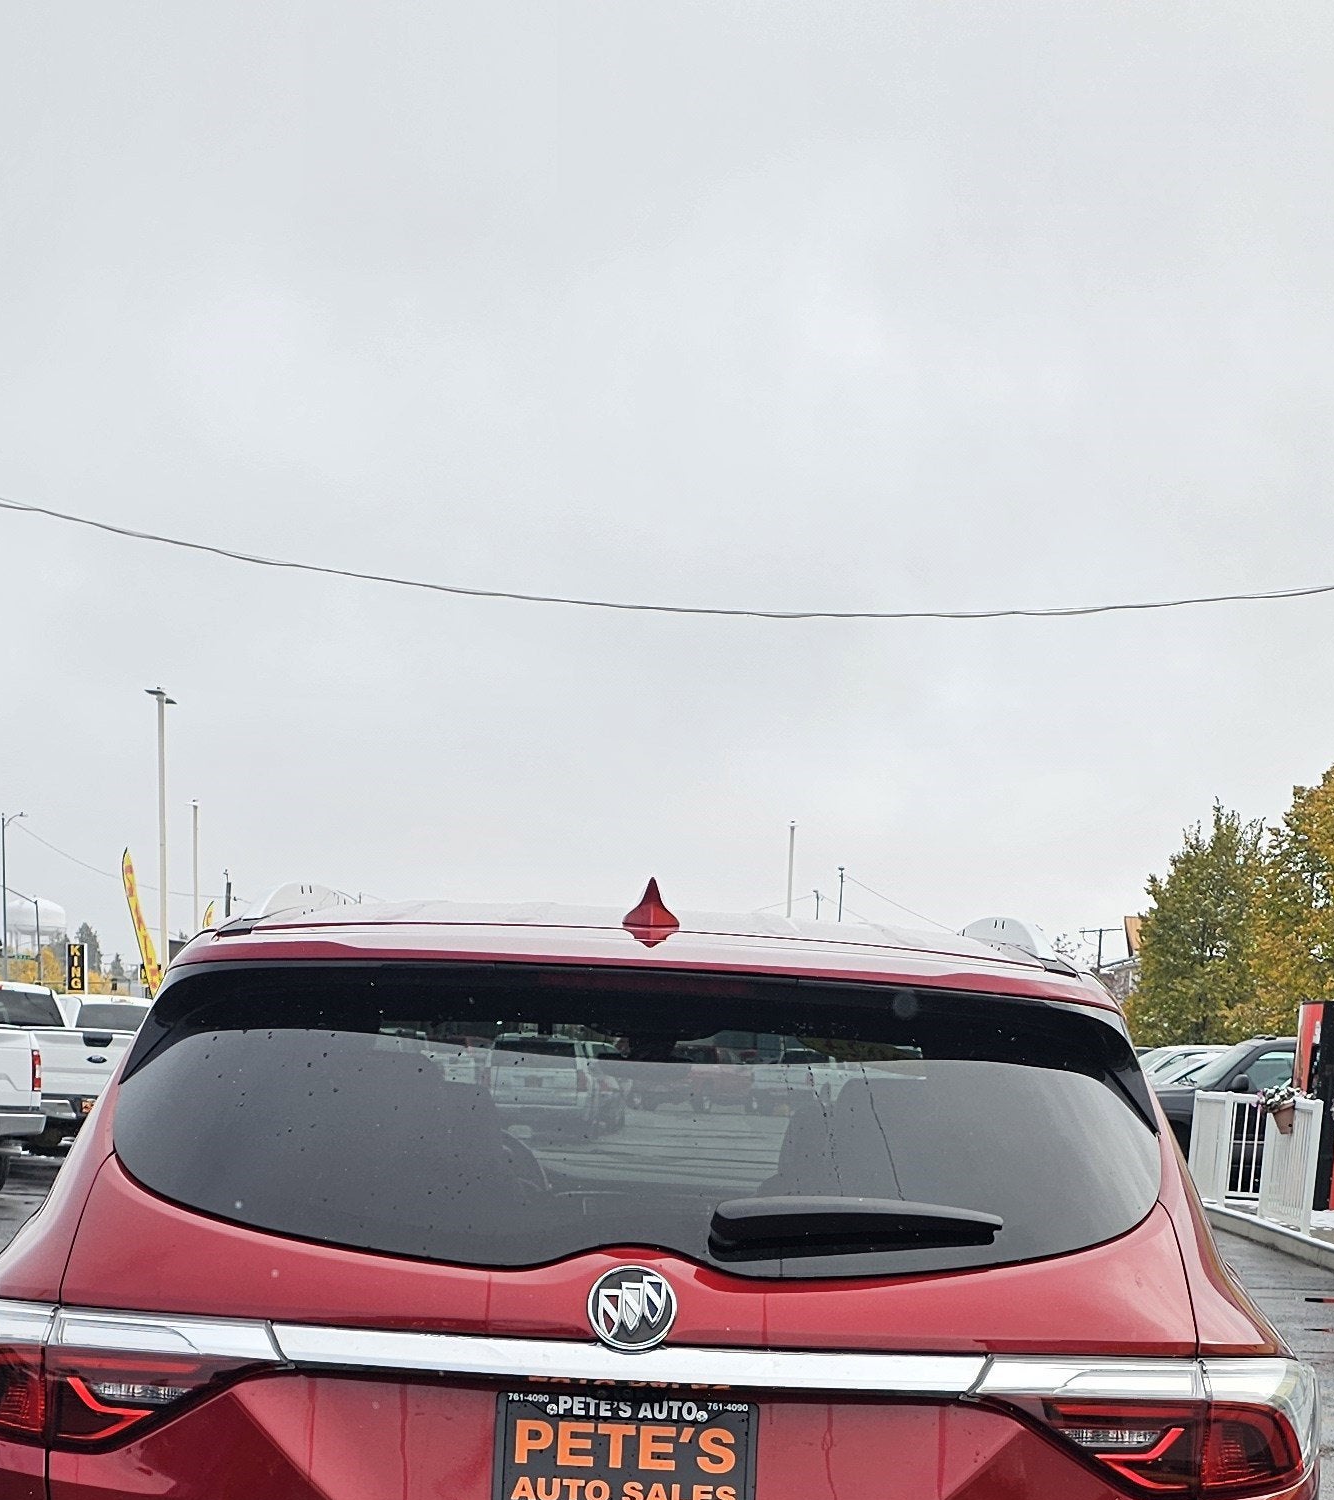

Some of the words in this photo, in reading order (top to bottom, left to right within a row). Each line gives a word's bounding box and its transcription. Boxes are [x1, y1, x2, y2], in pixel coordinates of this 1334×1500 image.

[70, 944, 82, 989] KING
[508, 1393, 549, 1403] 761-4090
[558, 1396, 632, 1418] PETE'S
[638, 1401, 697, 1420] AUTO
[707, 1402, 749, 1412] 761-4090
[514, 1419, 737, 1474] PETE'S
